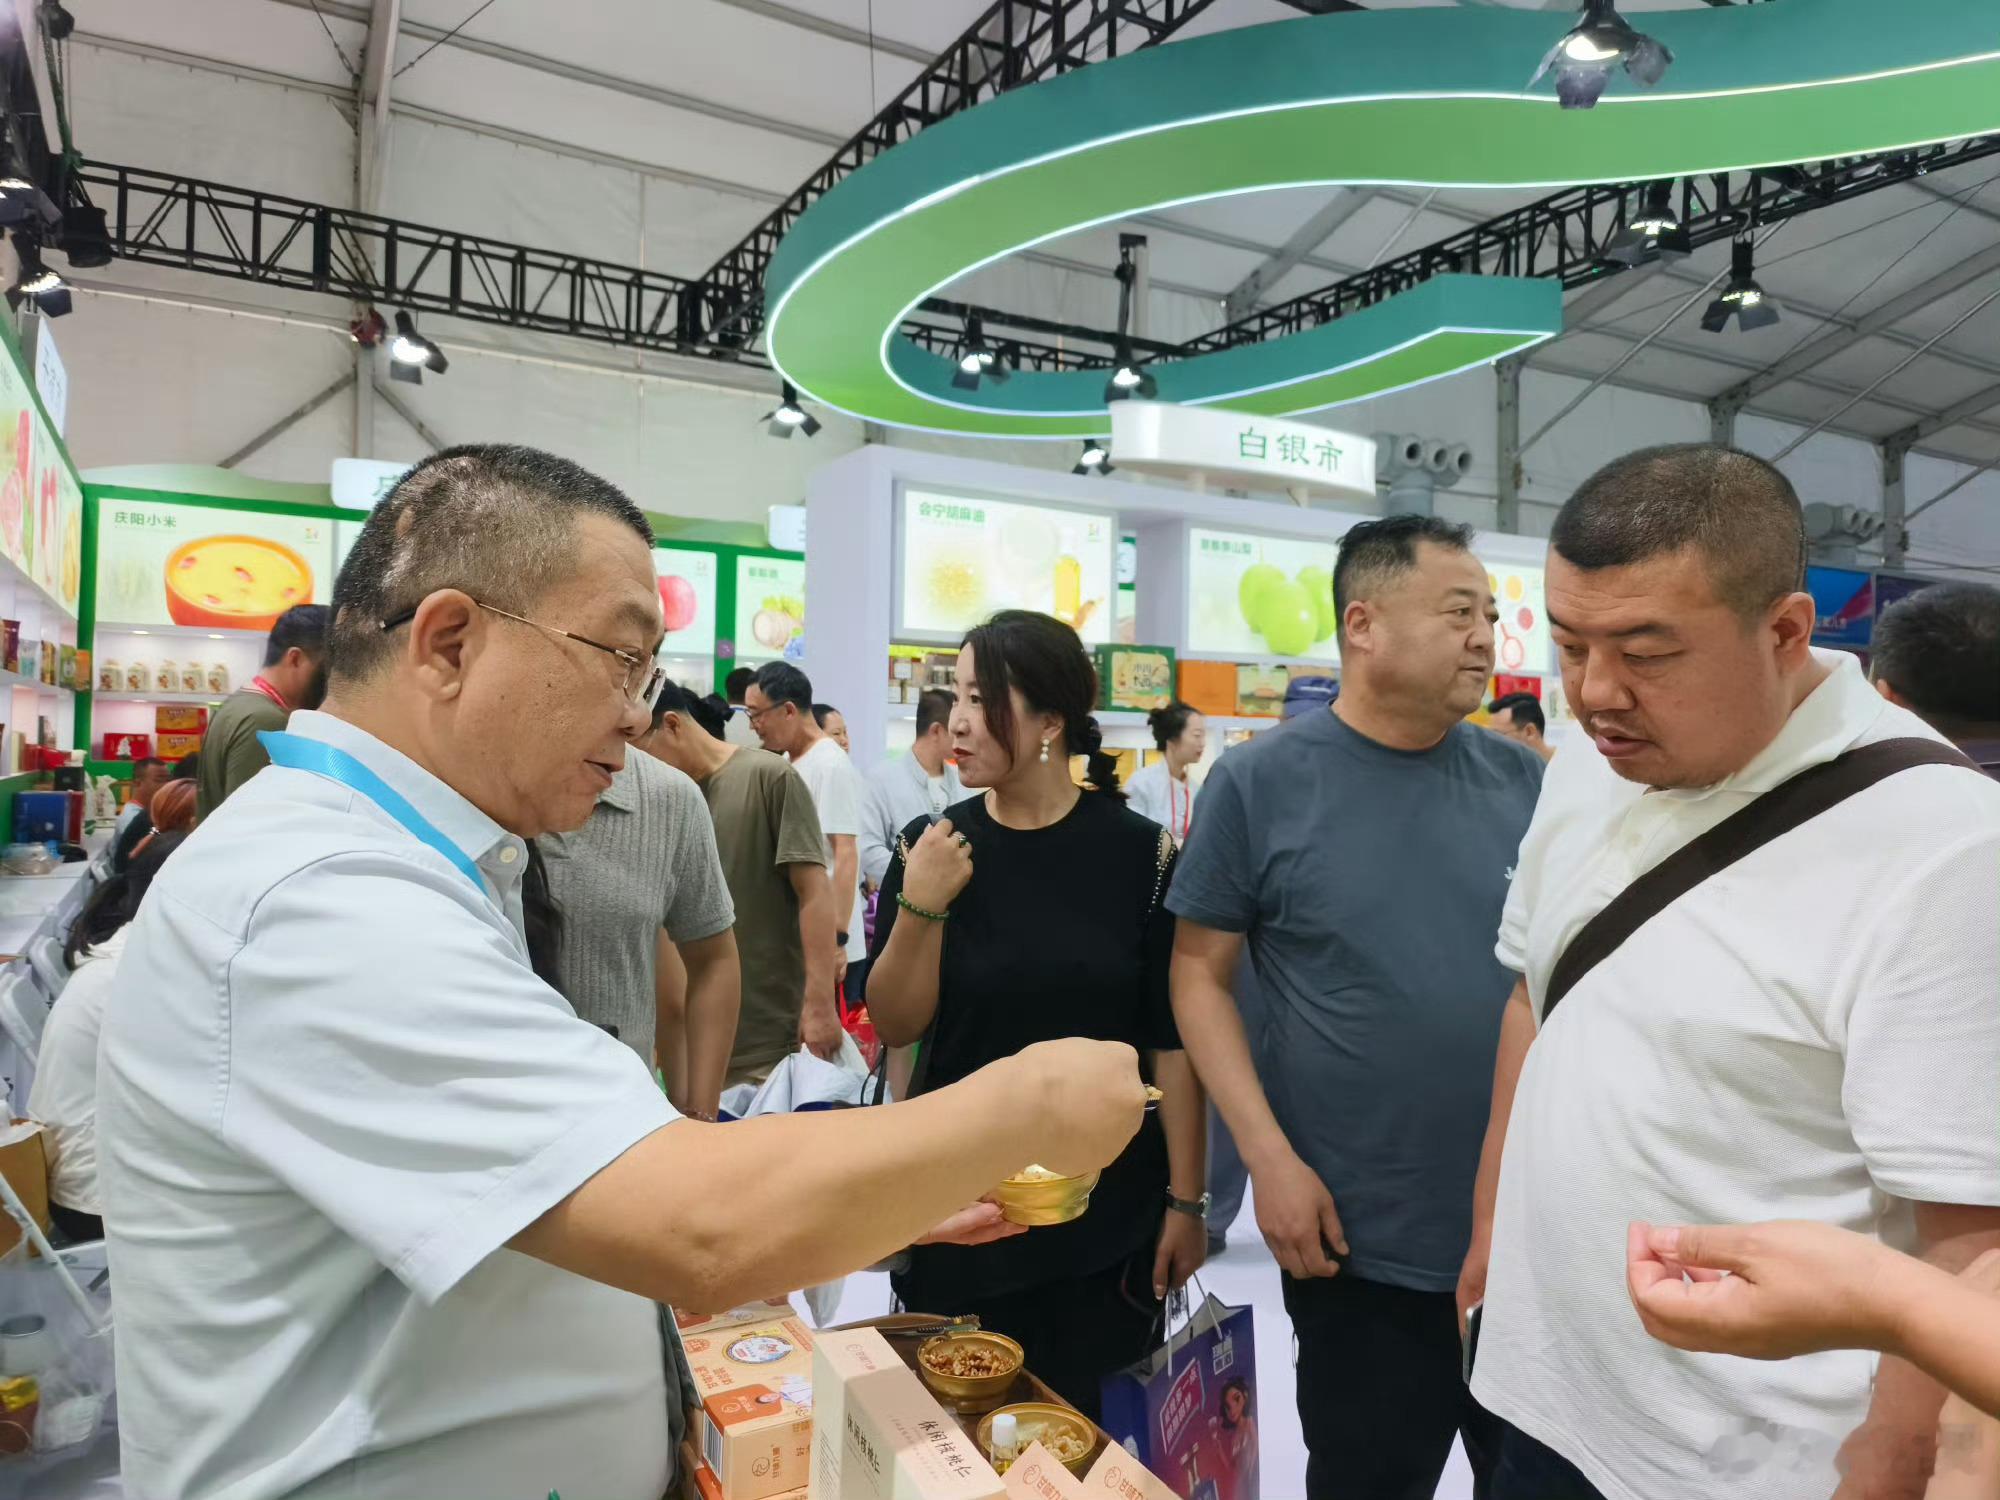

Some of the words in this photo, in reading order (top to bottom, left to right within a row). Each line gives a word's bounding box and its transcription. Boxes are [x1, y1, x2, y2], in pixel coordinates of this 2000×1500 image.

[1240, 426, 1343, 471] 白银市
[115, 511, 176, 528] 庆阳小米
[917, 1420, 973, 1478] 休闲核桃仁
